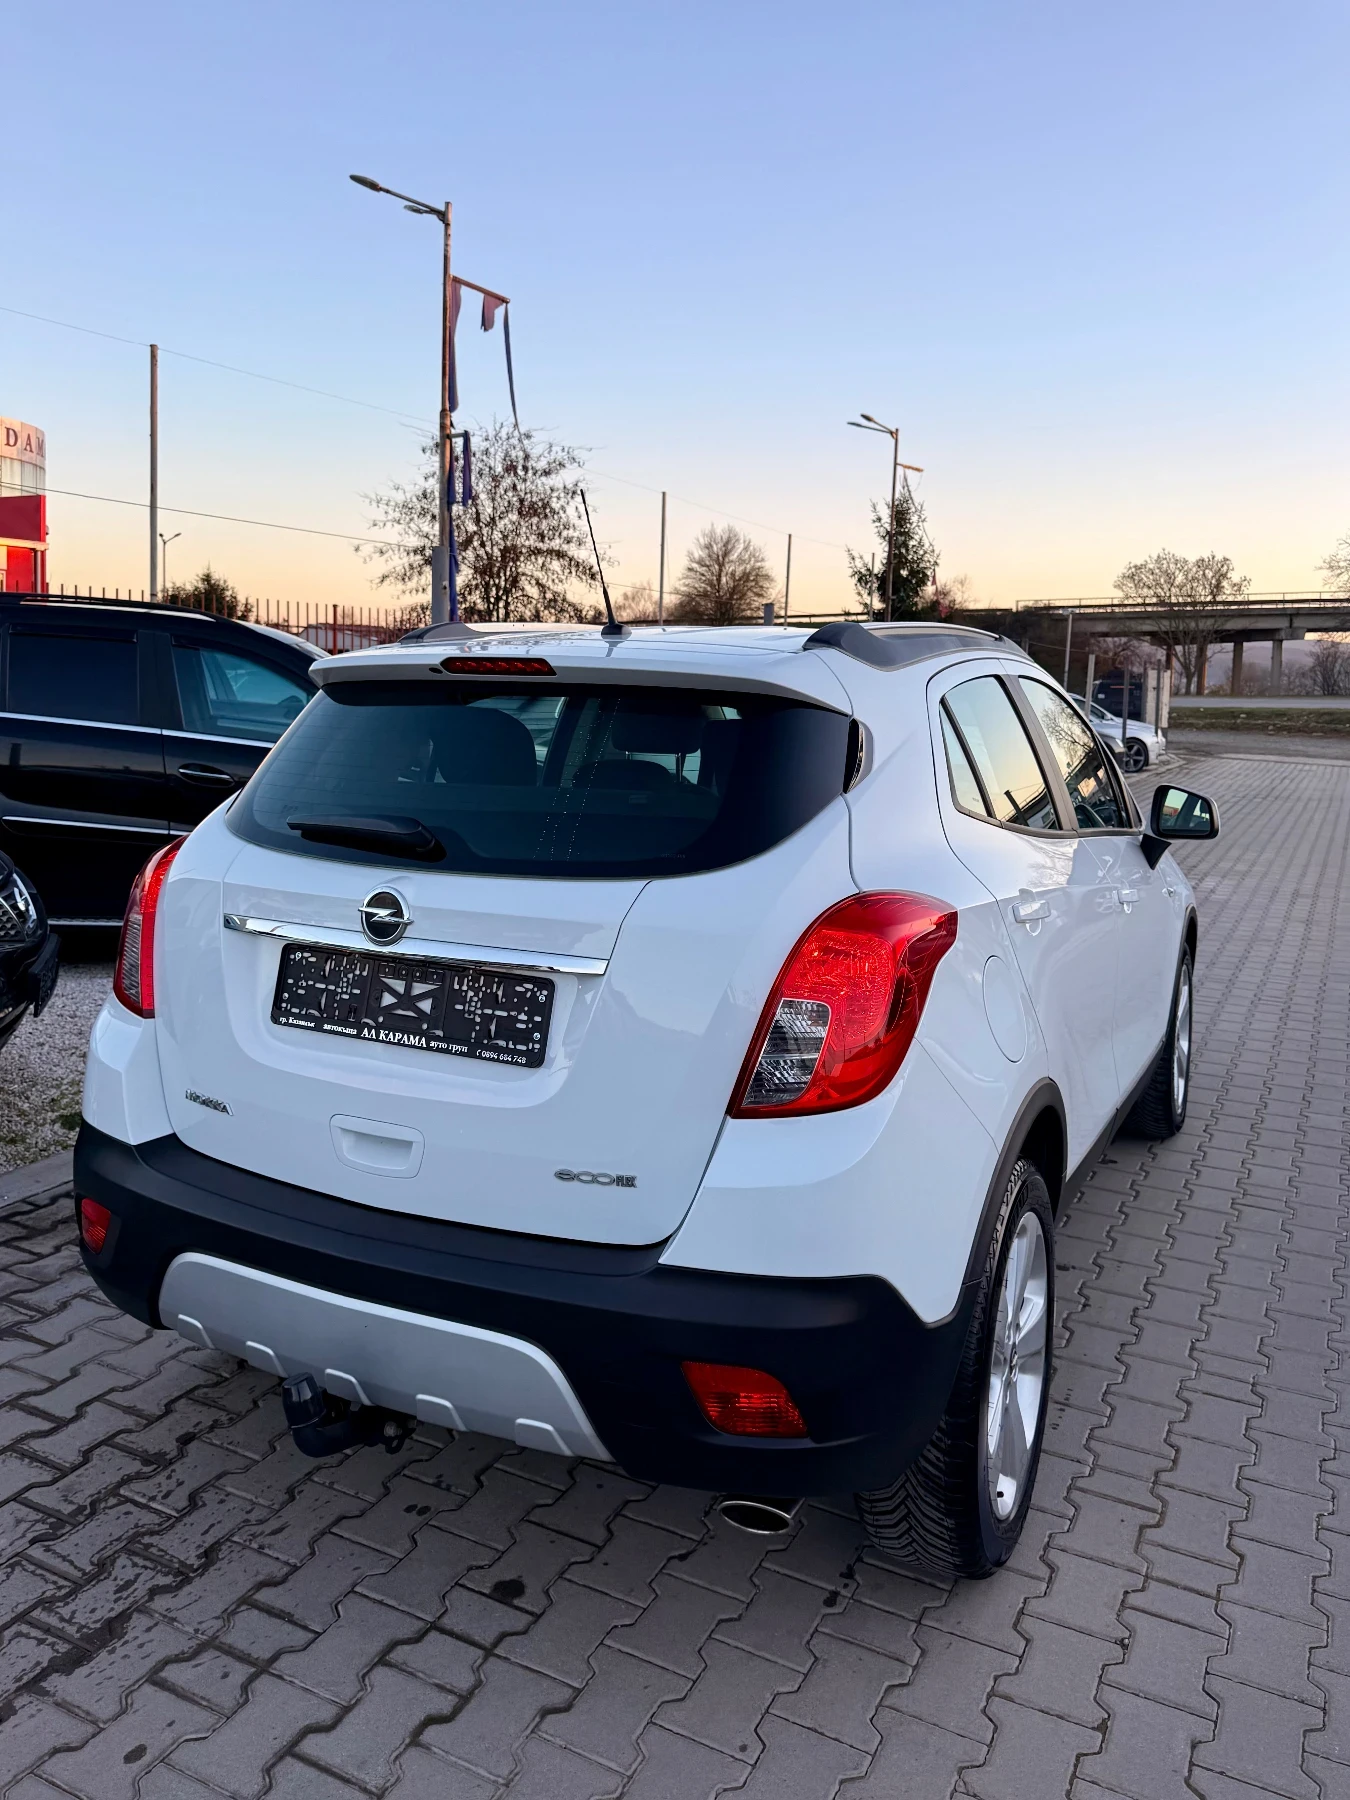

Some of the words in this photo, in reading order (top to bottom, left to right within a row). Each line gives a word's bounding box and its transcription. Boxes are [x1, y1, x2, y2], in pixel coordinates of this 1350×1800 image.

[379, 1029, 427, 1048] КАРАМА
[429, 1040, 447, 1050] ауто
[448, 1043, 468, 1054] груп
